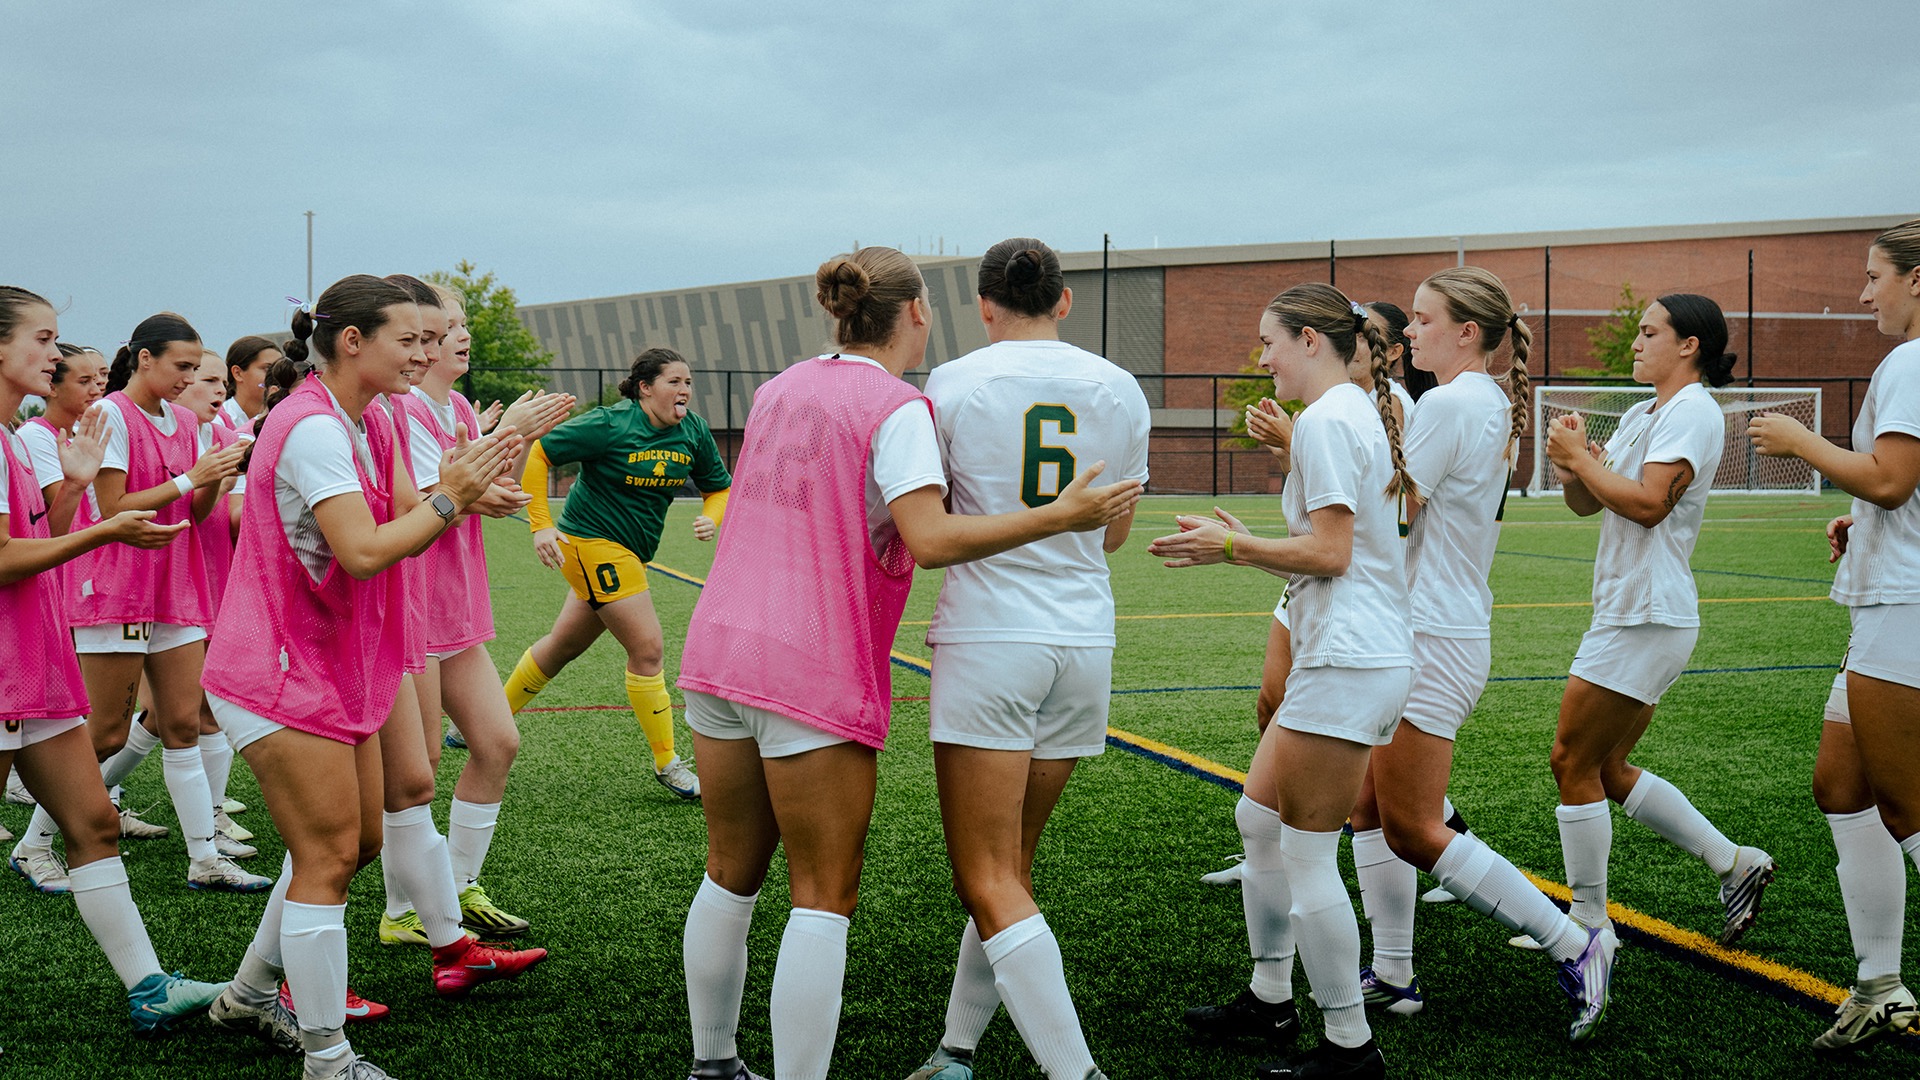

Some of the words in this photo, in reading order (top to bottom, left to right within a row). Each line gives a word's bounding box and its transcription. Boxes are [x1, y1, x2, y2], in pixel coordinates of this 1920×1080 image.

[628, 450, 692, 465] BROCKPORT
[1019, 402, 1077, 509] 6
[625, 475, 659, 487] SWIM
[659, 478, 666, 487] &
[596, 562, 621, 594] 0
[1855, 1001, 1915, 1040] AIR
